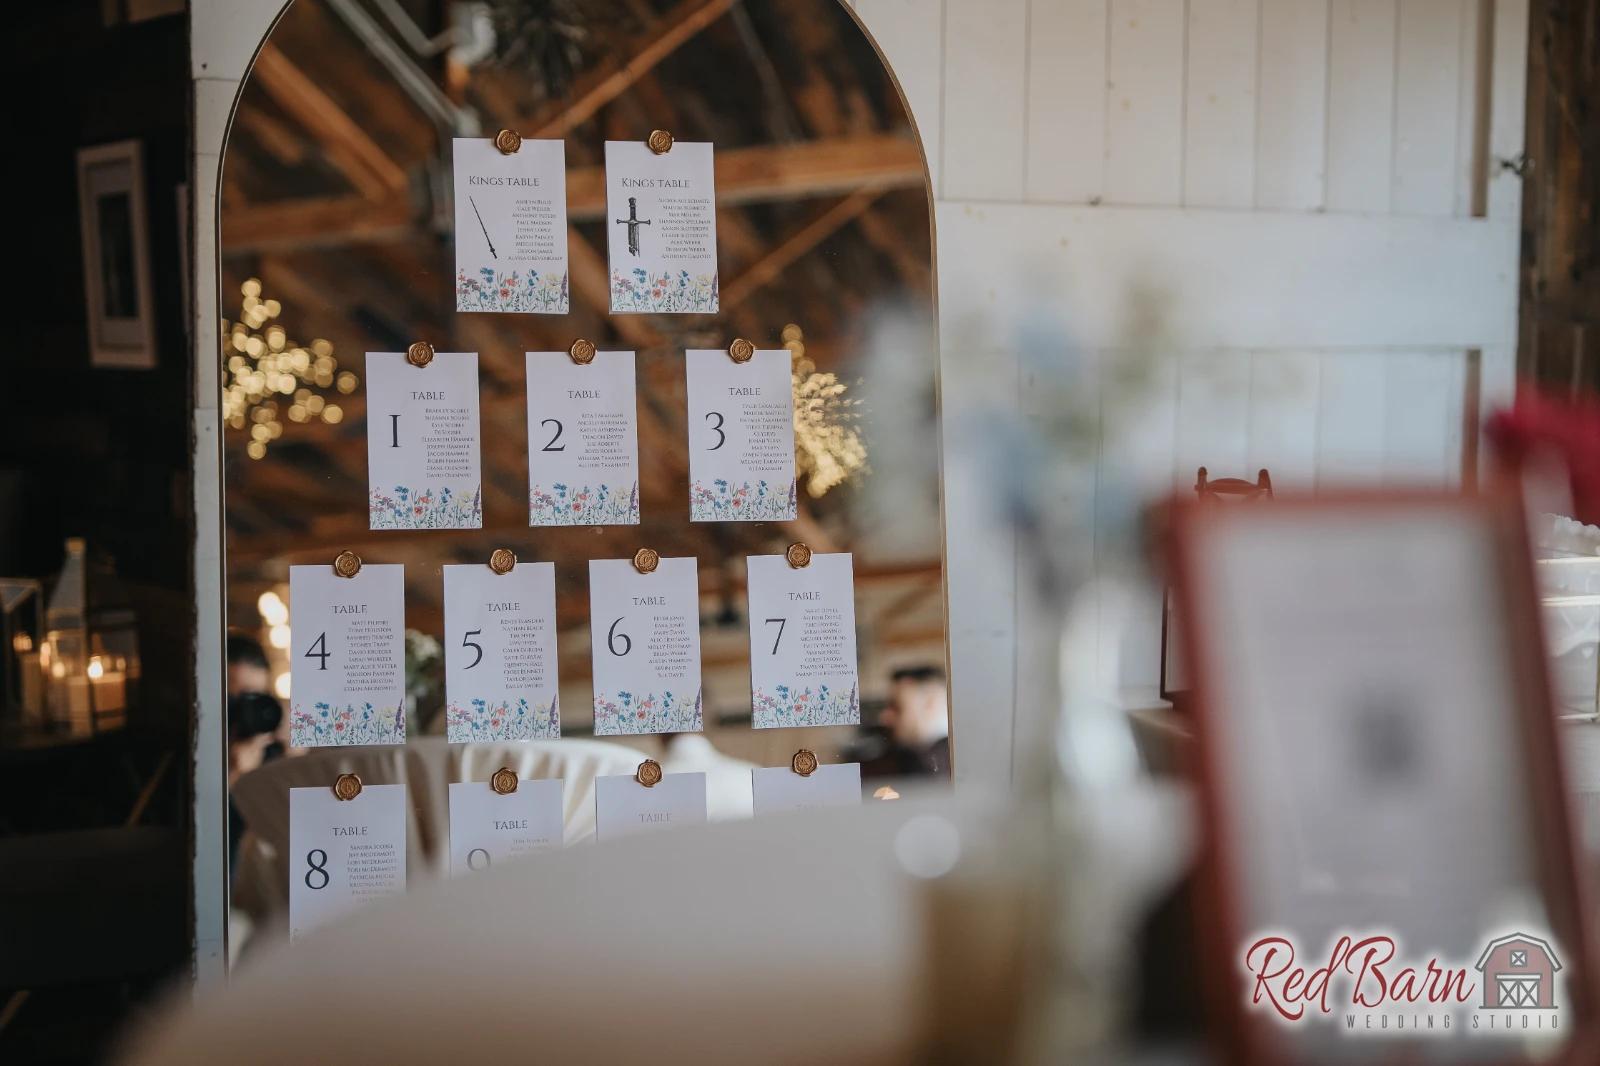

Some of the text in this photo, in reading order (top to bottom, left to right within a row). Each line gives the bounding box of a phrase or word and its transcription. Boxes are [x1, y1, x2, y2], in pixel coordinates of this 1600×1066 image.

[469, 176, 540, 186] KINGS TABLE
[622, 178, 690, 188] KINGS TABLE
[410, 391, 445, 400] TABLE
[568, 390, 600, 398] TABLE
[541, 418, 566, 451] 2
[705, 412, 725, 450] 3
[788, 592, 820, 600] TABLE
[486, 602, 520, 611] TABLE
[632, 597, 666, 606] TABLE
[332, 605, 367, 614] TABLE
[608, 616, 631, 656] 6
[765, 618, 786, 655] 7
[304, 632, 331, 670] 4
[462, 629, 482, 670] 5
[493, 820, 528, 829] TABLE
[332, 826, 368, 836] TABLE
[305, 849, 329, 890] 8
